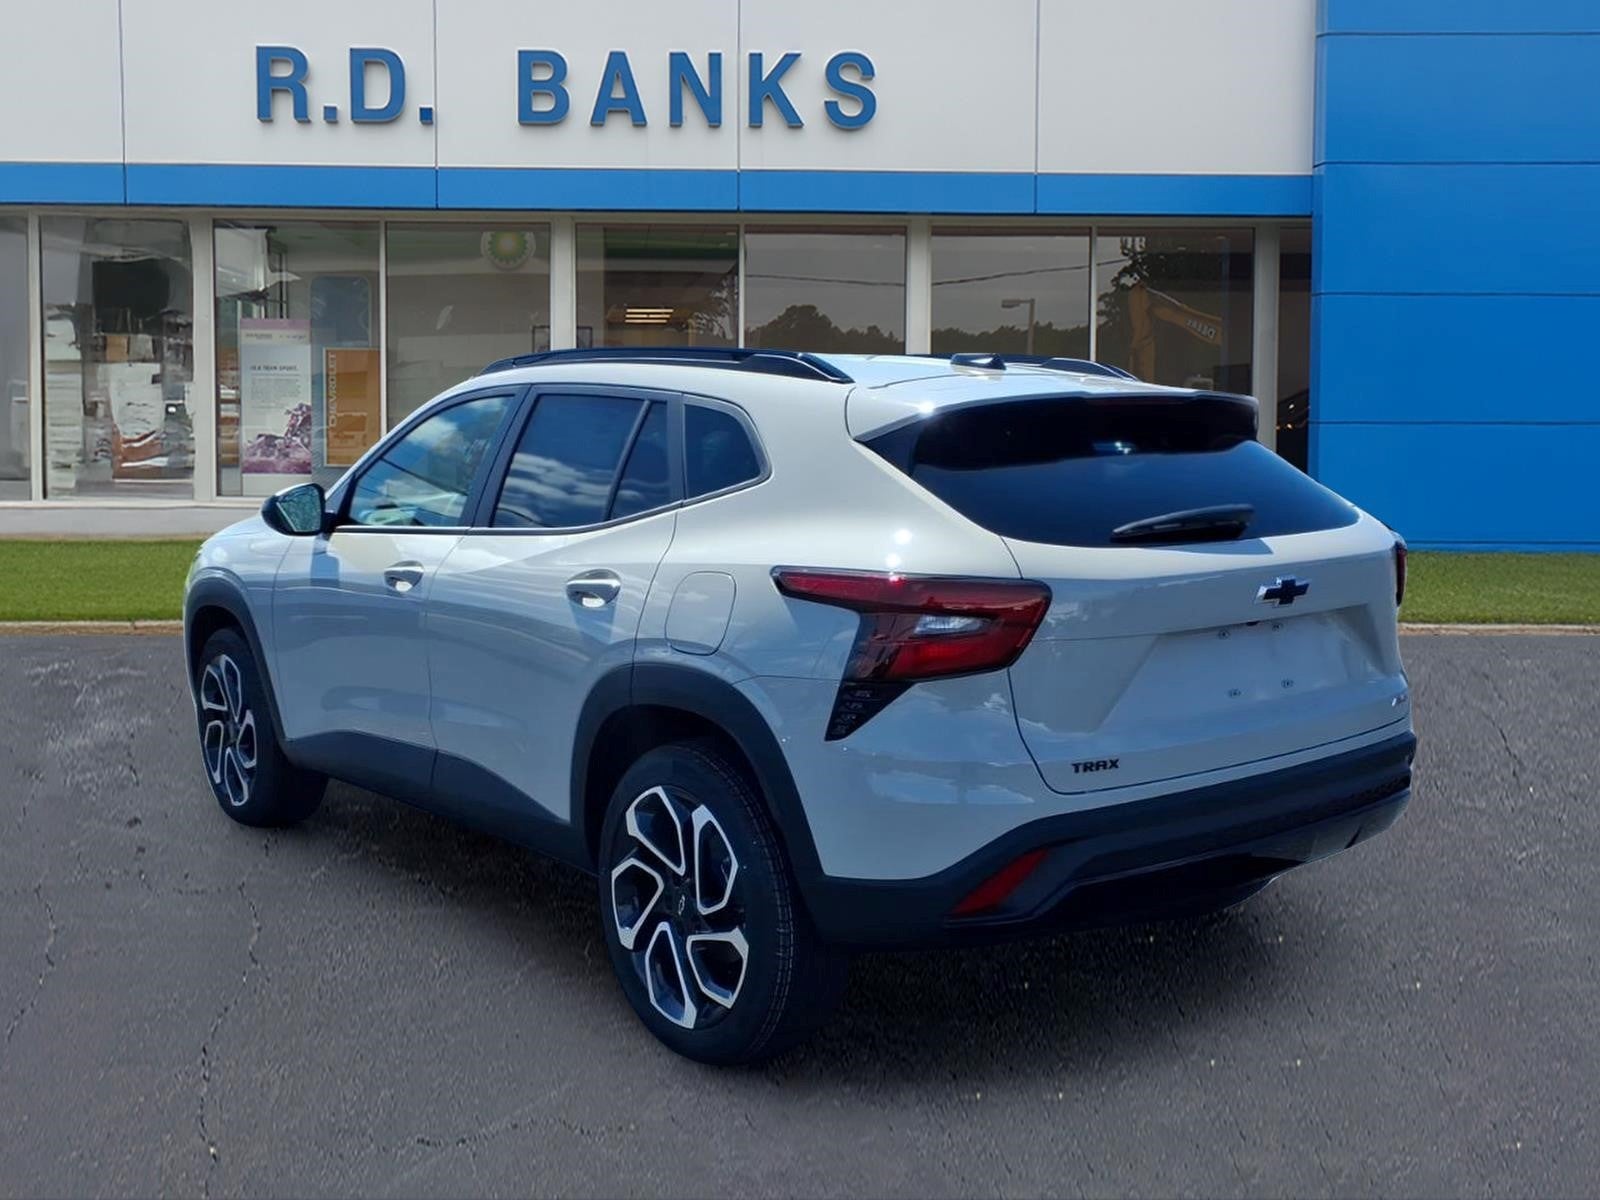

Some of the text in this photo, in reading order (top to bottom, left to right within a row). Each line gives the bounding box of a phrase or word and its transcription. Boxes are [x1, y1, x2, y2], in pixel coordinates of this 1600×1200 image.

[255, 46, 878, 129] R.D. BANKS
[1071, 758, 1120, 774] TRAX
